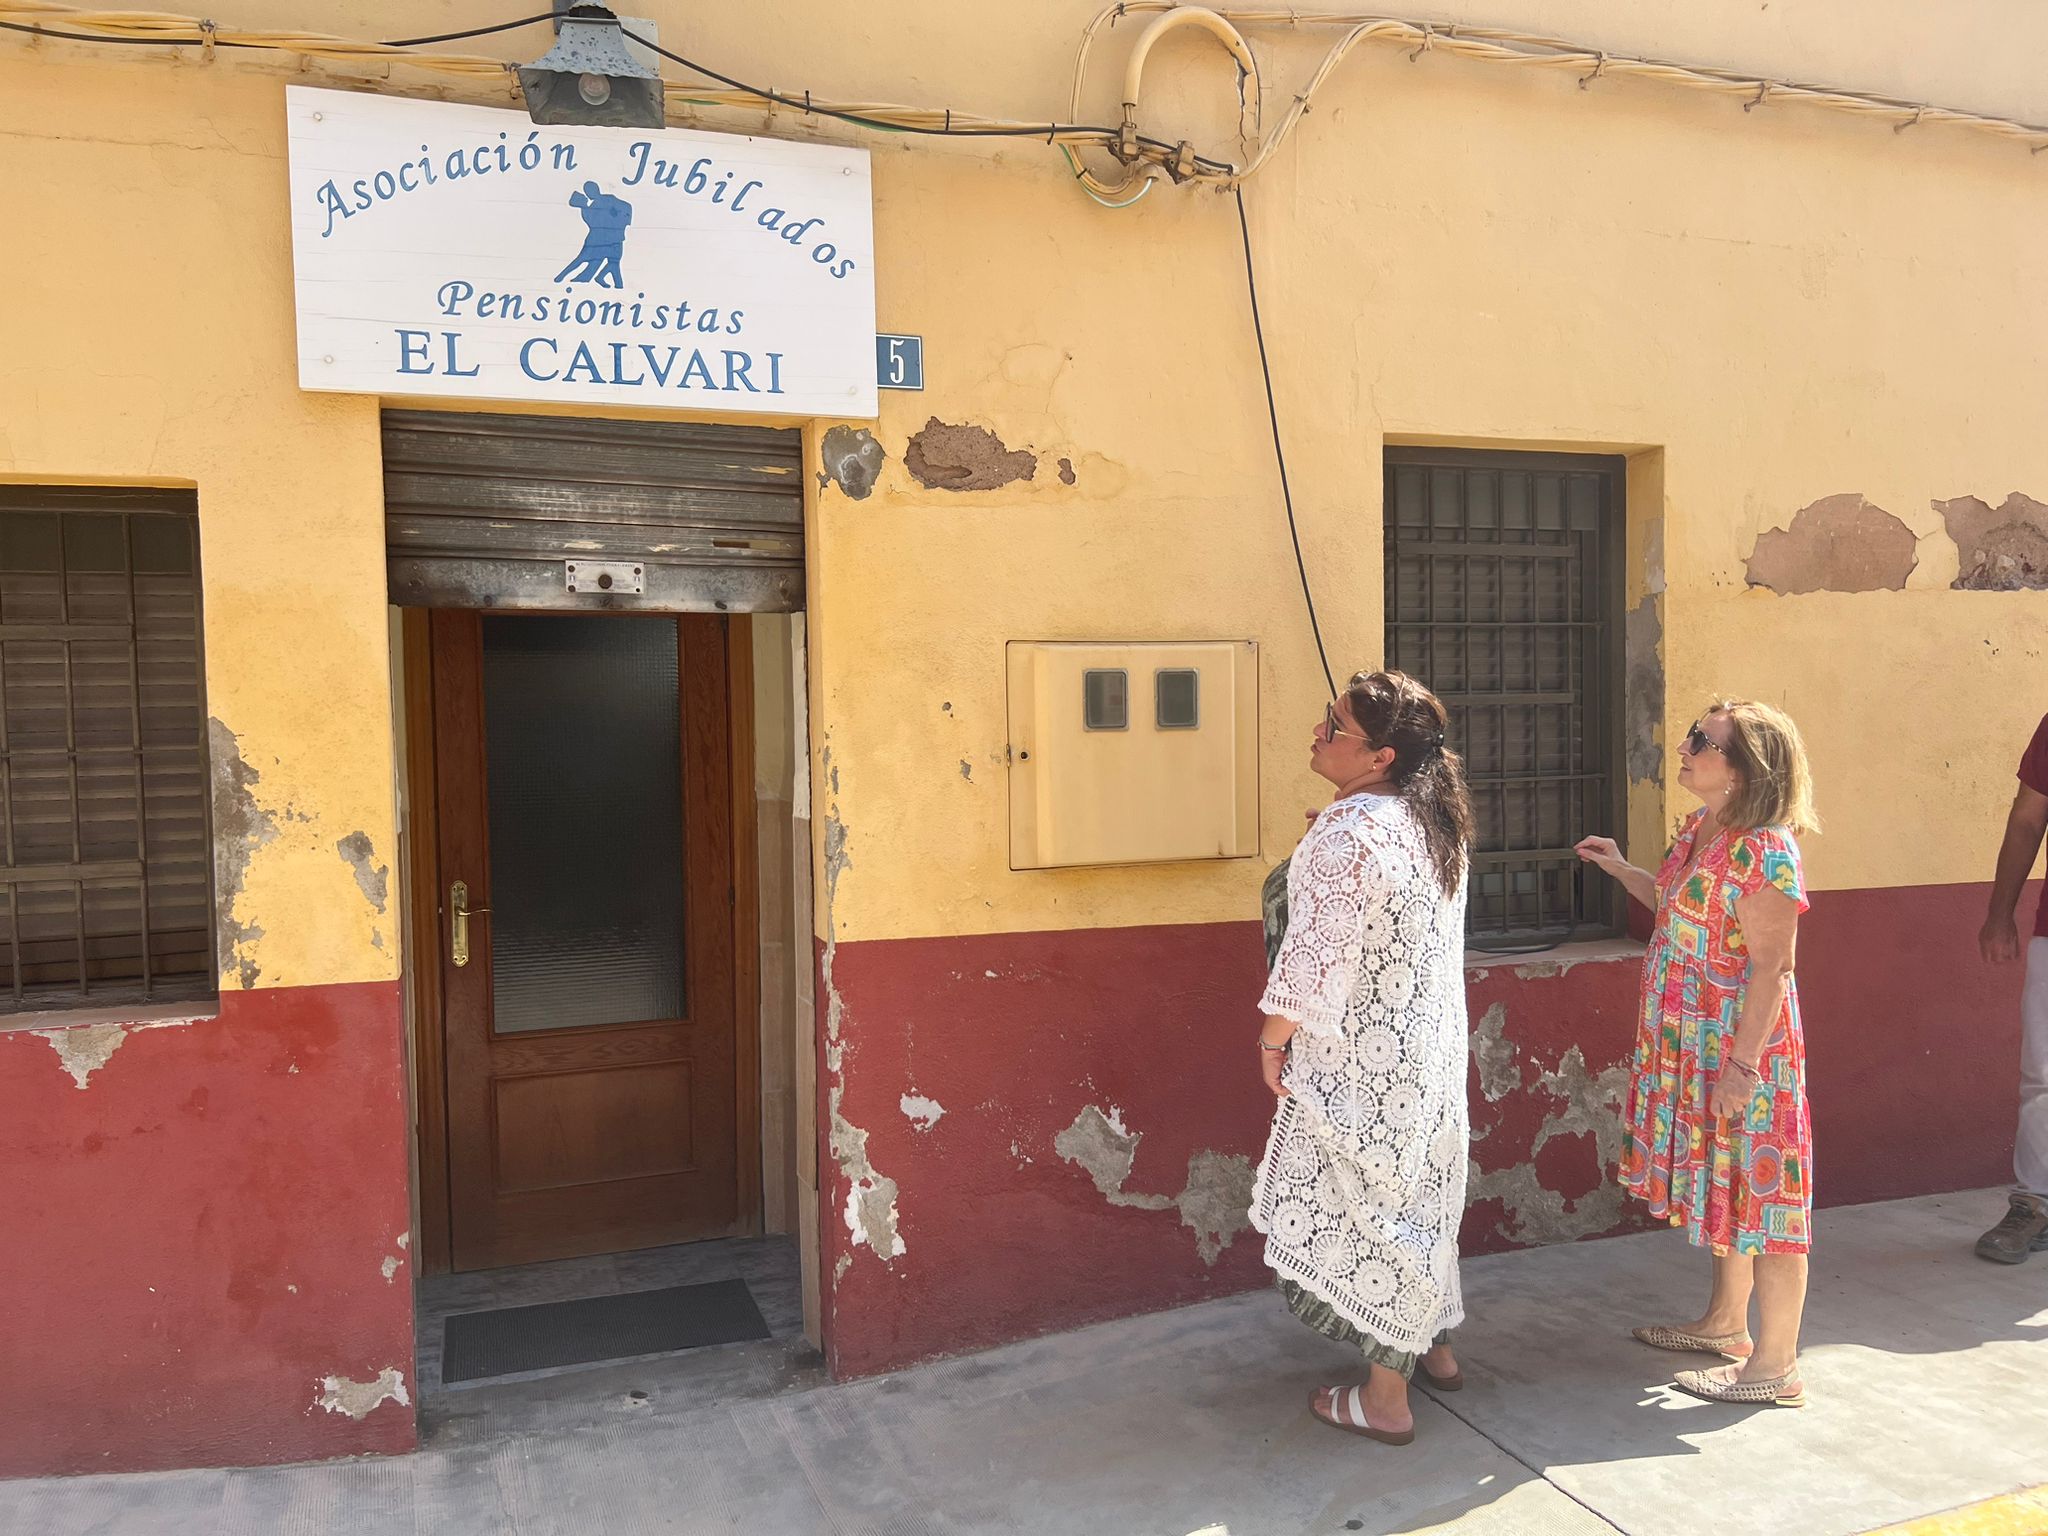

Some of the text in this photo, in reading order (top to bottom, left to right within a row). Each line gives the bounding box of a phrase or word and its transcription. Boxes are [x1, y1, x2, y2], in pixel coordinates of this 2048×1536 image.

[316, 131, 855, 280] Asociación Jubilados
[436, 280, 744, 335] Pensionistas
[394, 329, 784, 394] EL CALVARI
[889, 338, 904, 384] 5
